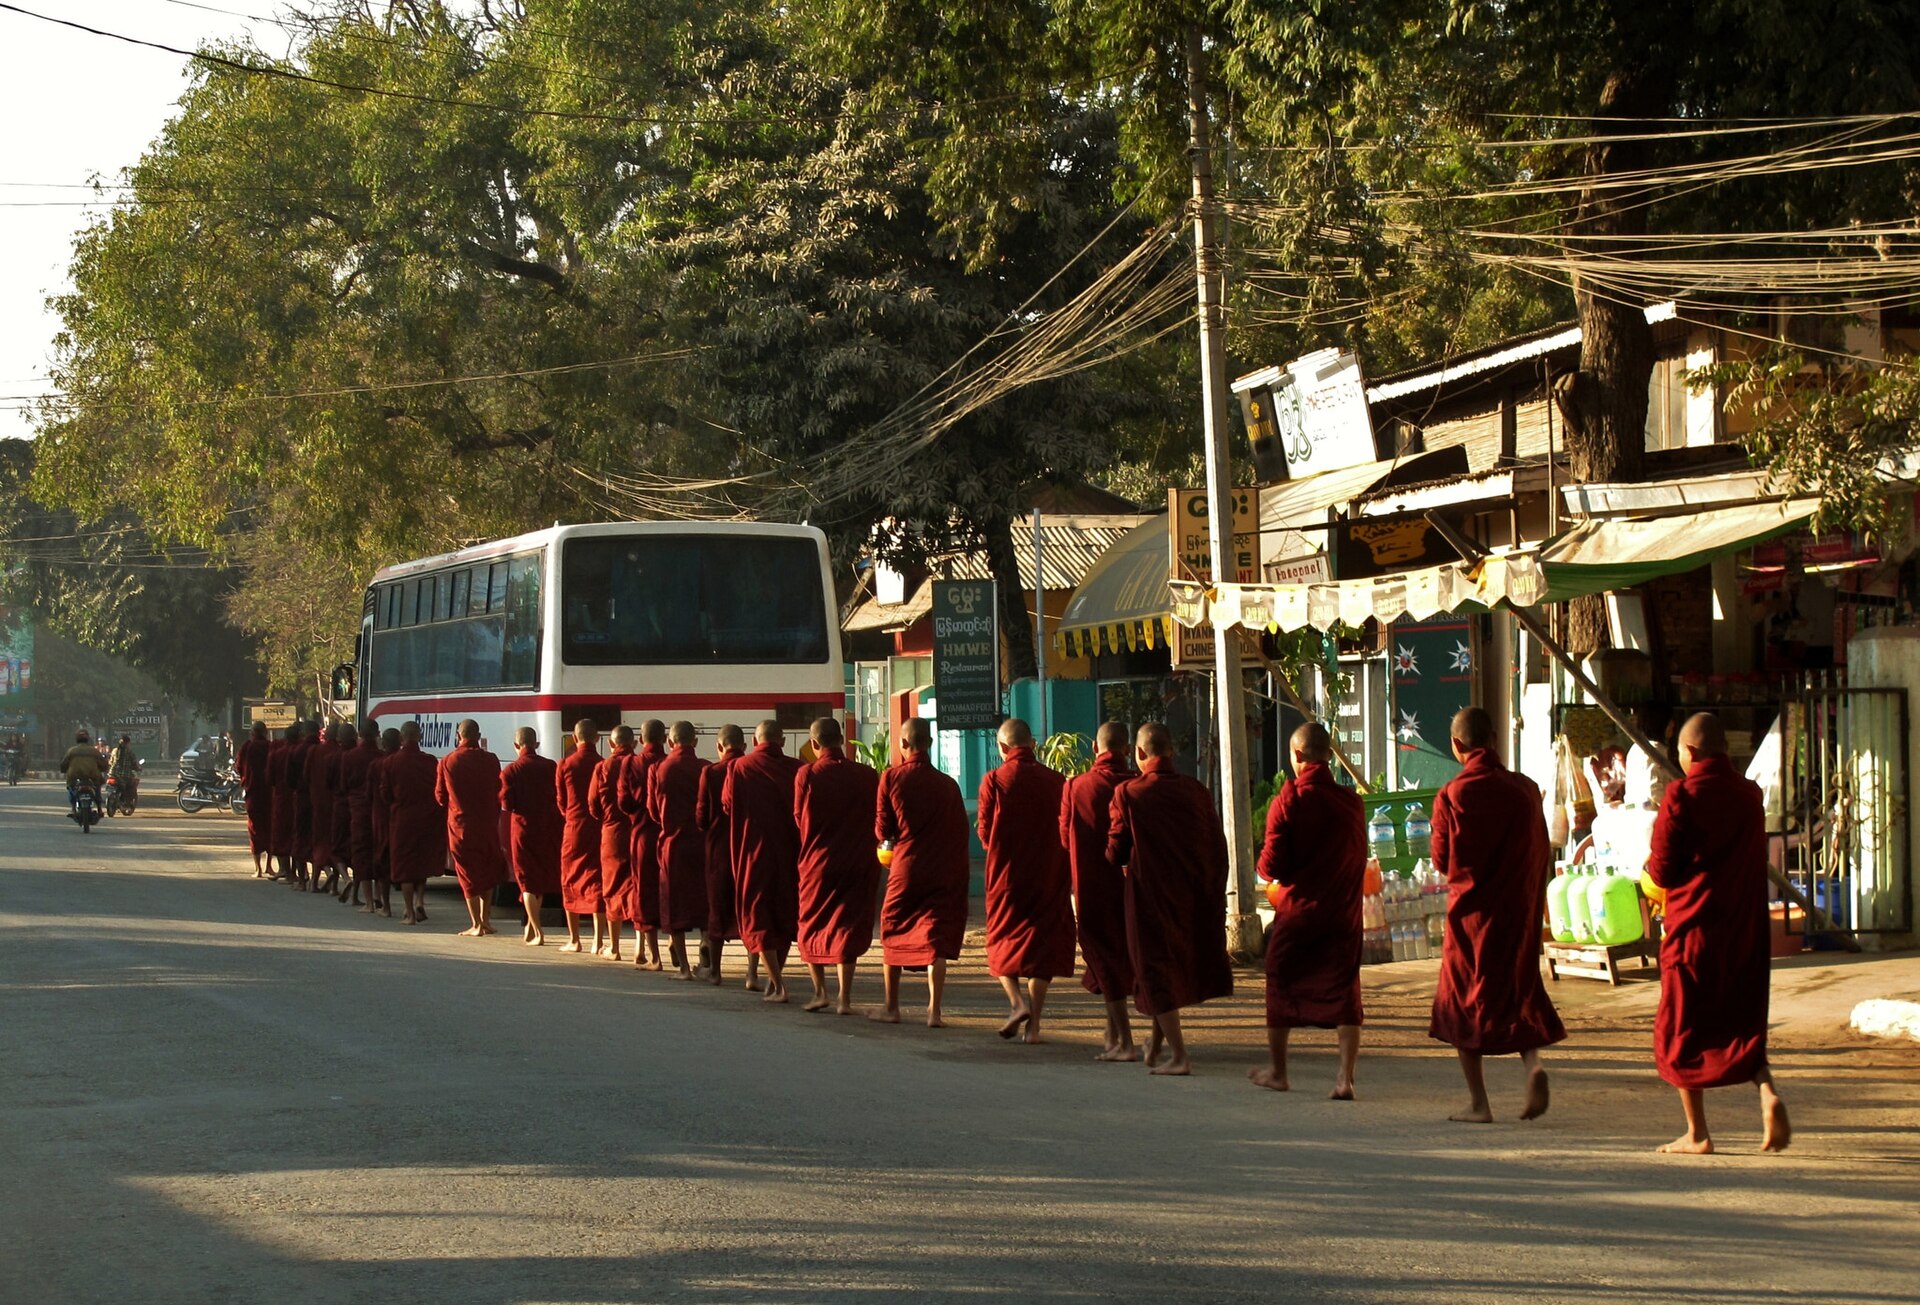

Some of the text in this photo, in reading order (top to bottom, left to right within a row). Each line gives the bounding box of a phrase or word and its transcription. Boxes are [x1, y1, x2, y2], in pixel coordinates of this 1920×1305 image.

[943, 643, 991, 656] HMWE
[1185, 643, 1214, 656] CHINE
[940, 661, 993, 674] Restaurant
[942, 714, 972, 723] CHINESE
